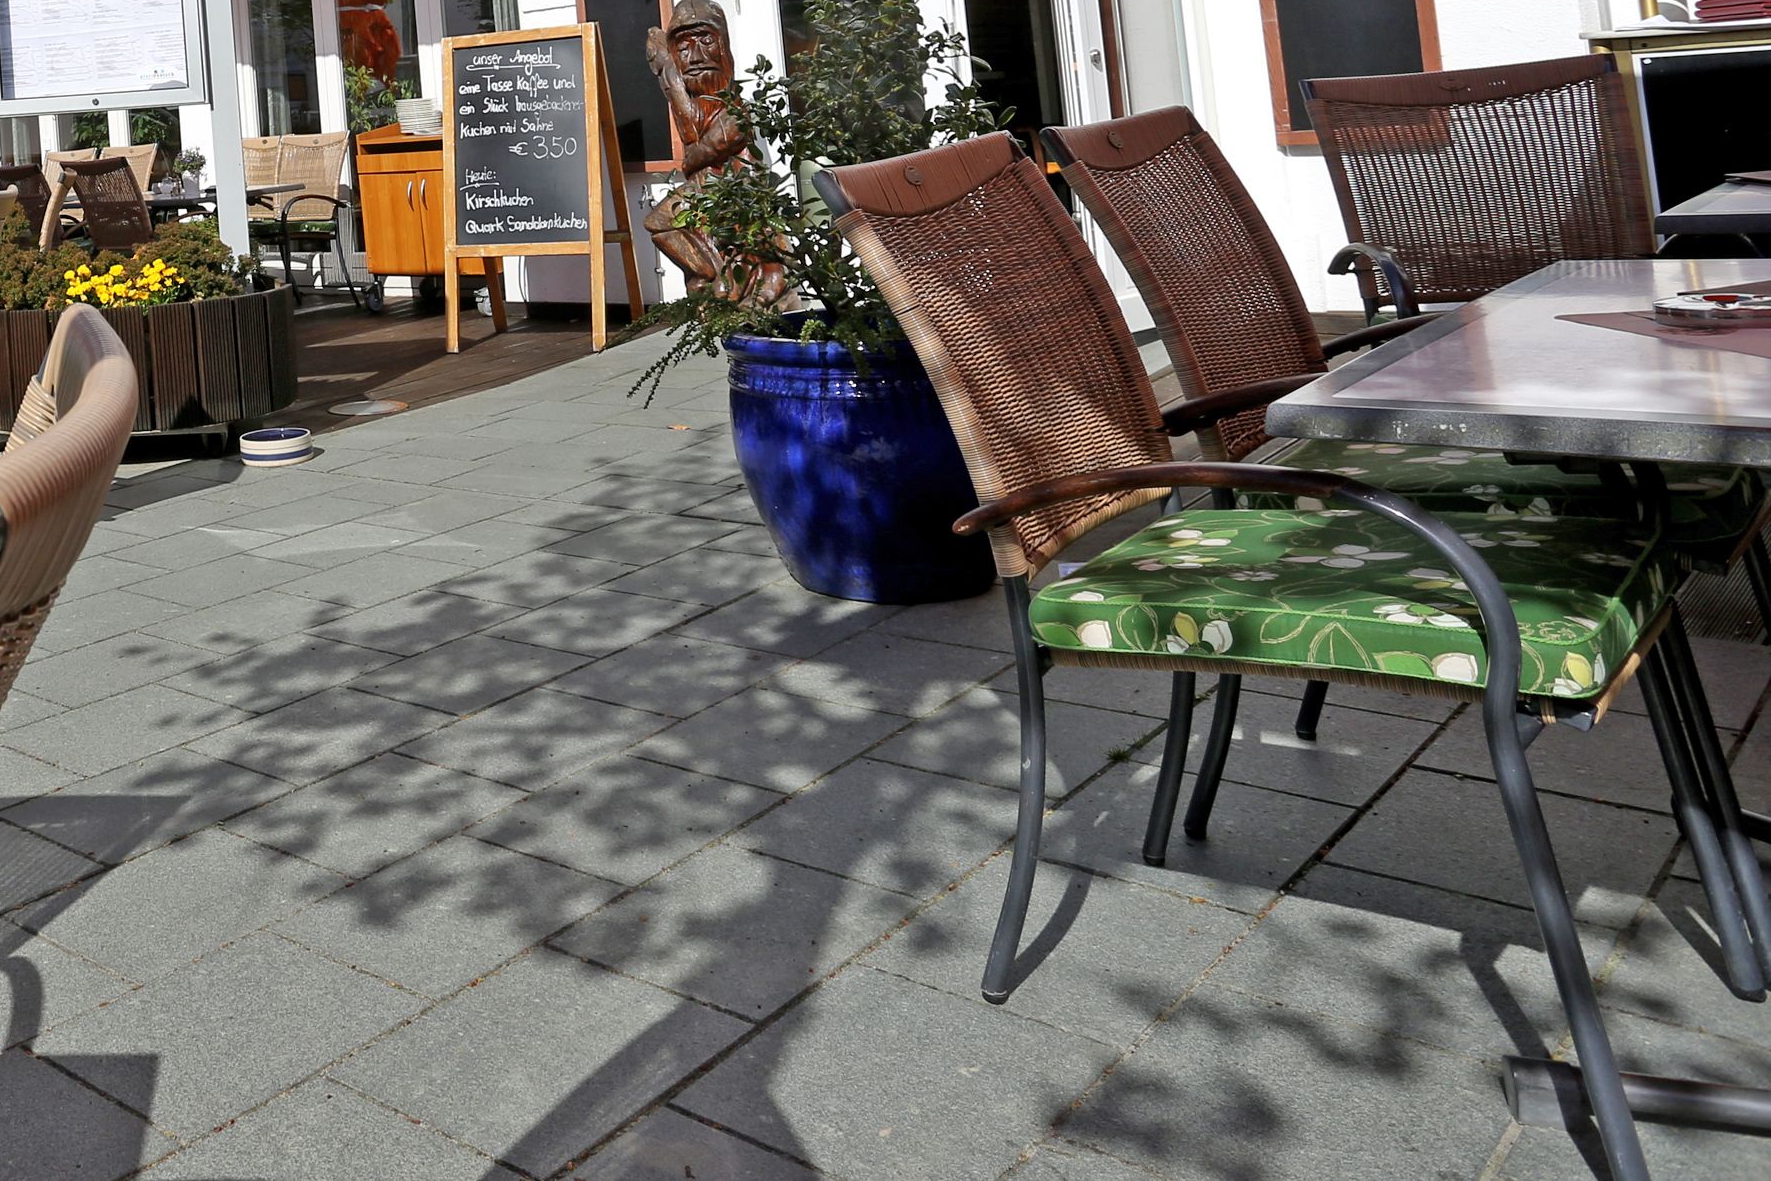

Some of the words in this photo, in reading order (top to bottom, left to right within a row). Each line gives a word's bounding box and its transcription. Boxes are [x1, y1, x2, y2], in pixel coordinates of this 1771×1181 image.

[472, 53, 503, 66] unser
[509, 46, 553, 75] Angebot
[458, 81, 481, 95] eine
[482, 74, 514, 92] Tasse
[516, 73, 549, 98] Kaffee
[553, 74, 576, 89] und
[459, 101, 475, 116] ein
[482, 97, 508, 114] Stück
[460, 121, 497, 139] Kuchen
[499, 119, 517, 134] mit
[520, 118, 554, 133] Sahne
[508, 141, 528, 156] €
[465, 166, 496, 185] Heute:
[465, 187, 534, 211] Kirschkuchen
[465, 216, 505, 234] Quark
